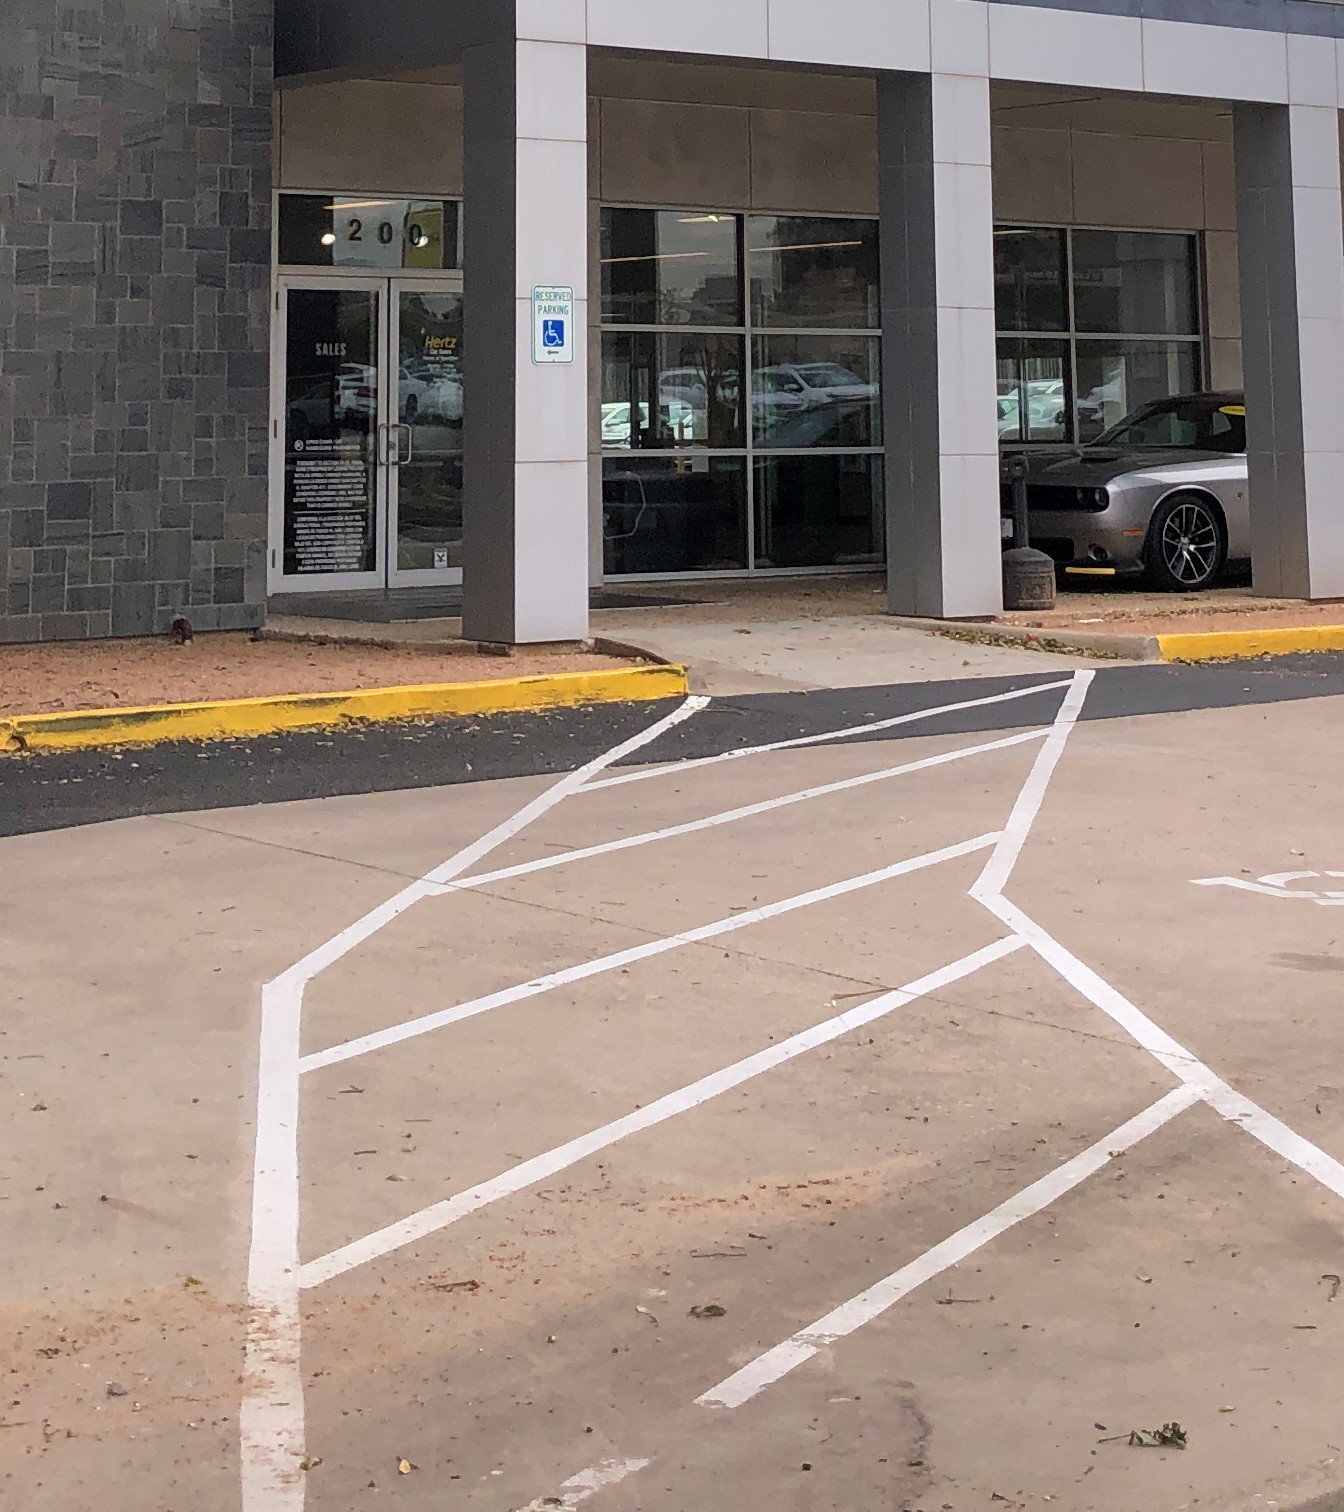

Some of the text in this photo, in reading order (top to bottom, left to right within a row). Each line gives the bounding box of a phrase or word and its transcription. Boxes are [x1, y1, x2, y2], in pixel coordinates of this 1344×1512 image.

[347, 218, 423, 246] 200
[535, 291, 572, 302] RESERVED
[538, 305, 569, 316] PARKING
[315, 342, 347, 356] SALES
[425, 336, 457, 349] Hertz
